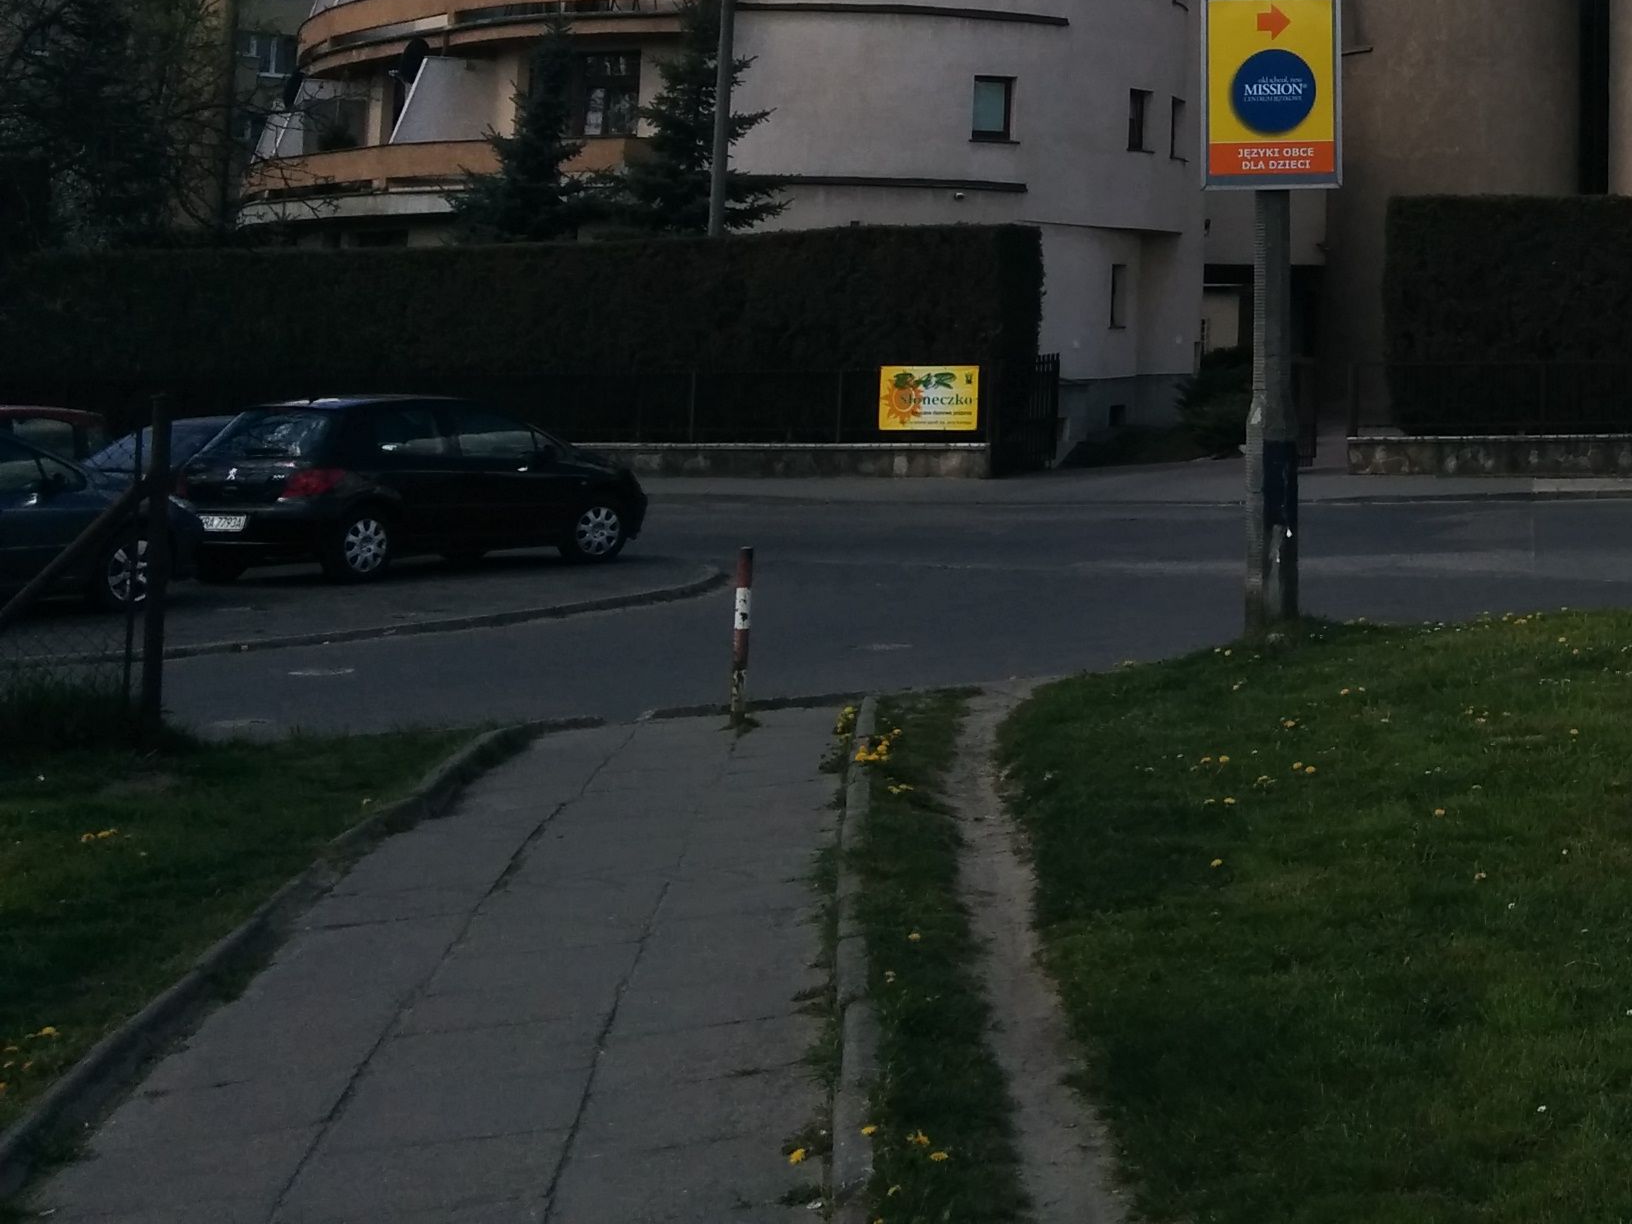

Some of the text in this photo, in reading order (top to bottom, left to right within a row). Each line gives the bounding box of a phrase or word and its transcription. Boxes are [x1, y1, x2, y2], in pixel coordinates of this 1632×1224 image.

[1238, 147, 1314, 159] JĘZYKI OBCE
[1242, 160, 1310, 170] DLA DZIECI
[893, 372, 957, 389] BAR
